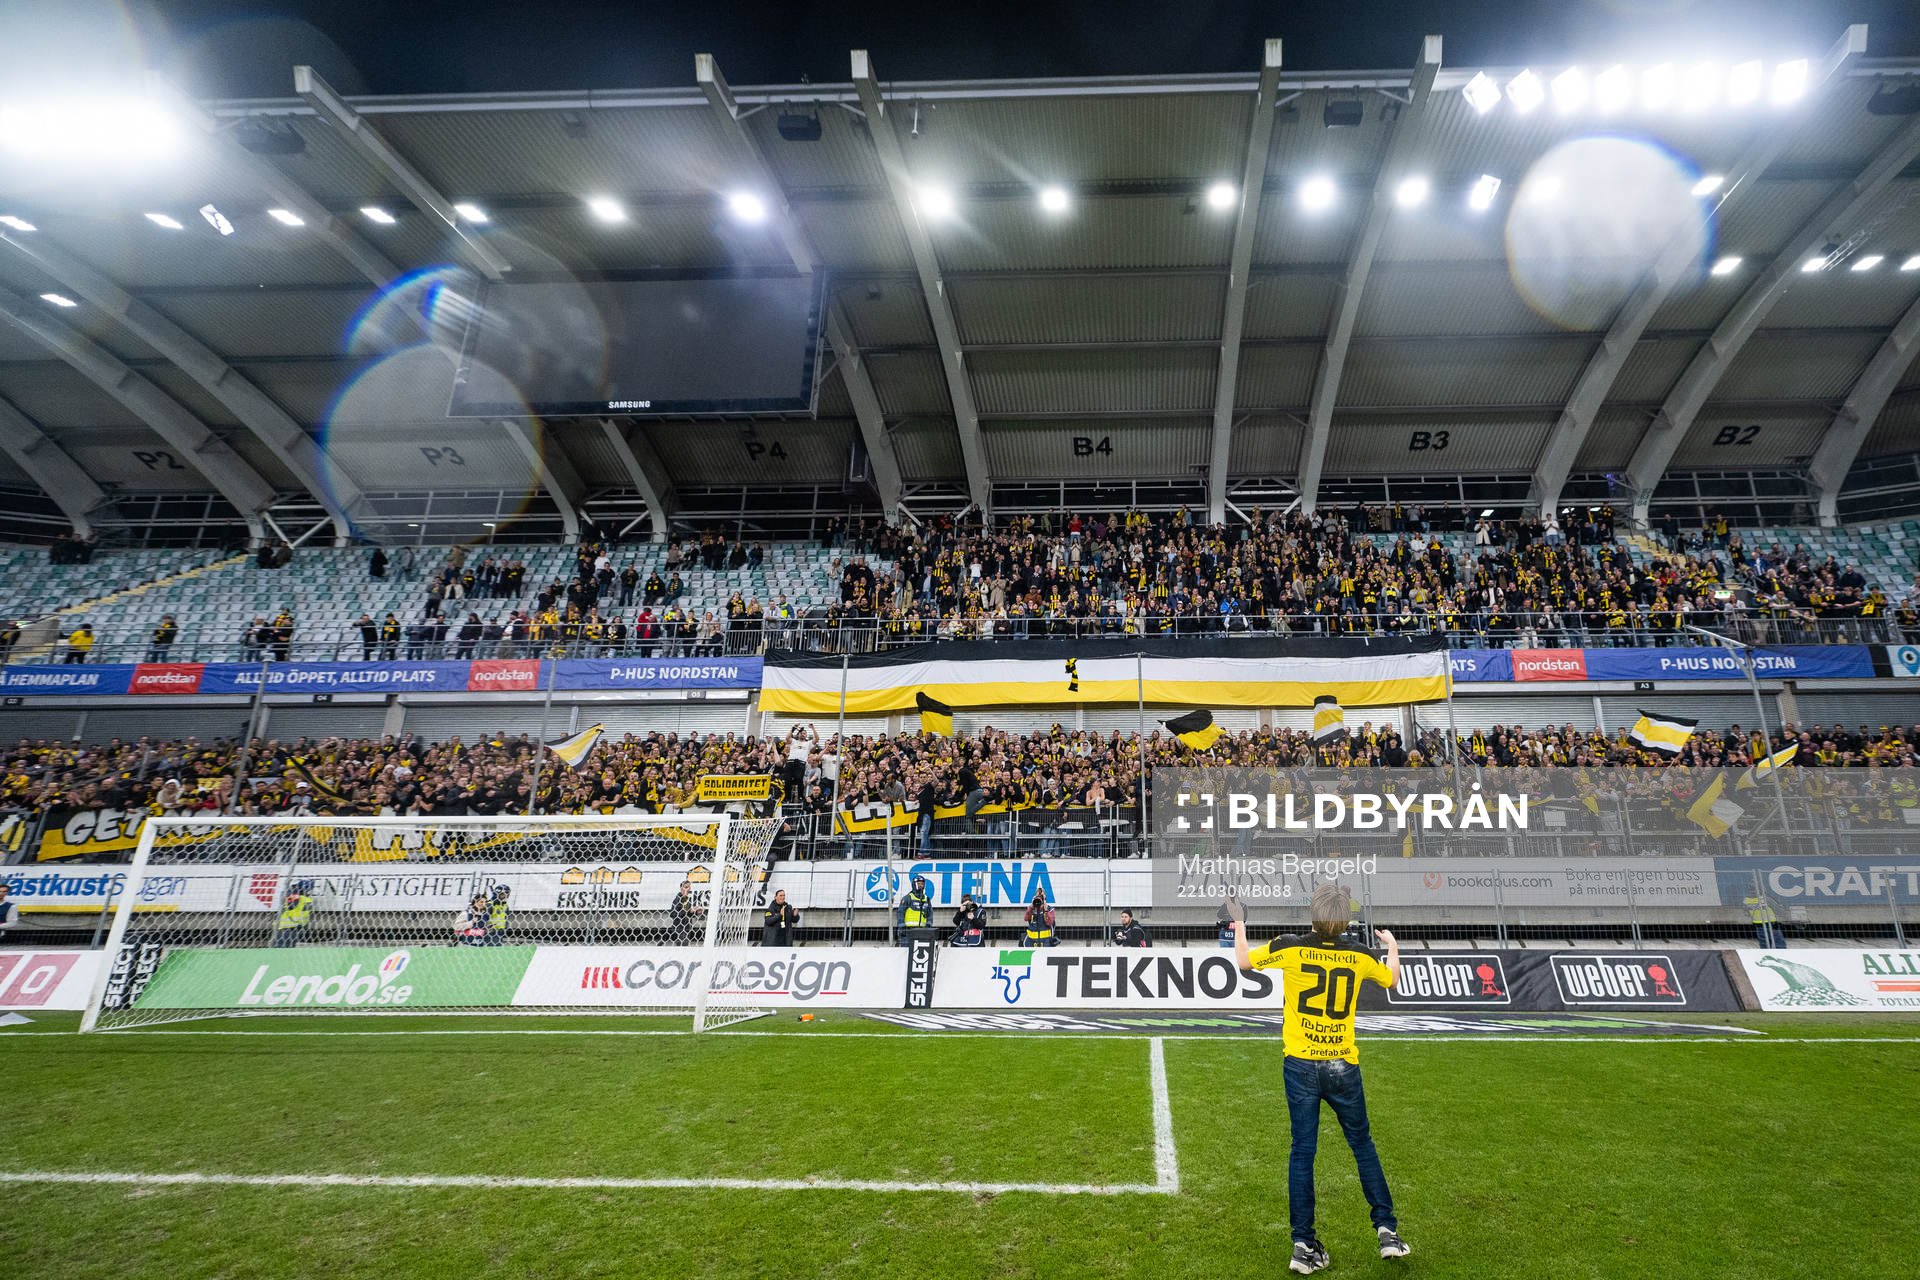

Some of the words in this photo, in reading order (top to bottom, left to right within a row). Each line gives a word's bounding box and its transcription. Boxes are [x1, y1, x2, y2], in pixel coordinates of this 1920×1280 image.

[608, 400, 650, 409] SAMSUNG
[1409, 431, 1450, 451] B3
[1713, 425, 1761, 446] B2
[420, 446, 466, 467] P3
[746, 441, 788, 461] P4
[1073, 437, 1113, 457] B4
[132, 450, 186, 471] P2
[610, 667, 656, 680] P-HUS
[658, 666, 738, 680] NORDSTAN
[1518, 658, 1580, 671] nordstan
[1660, 657, 1709, 671] P-HUS
[1712, 656, 1796, 671] NORDSTAN
[9, 673, 99, 686] HEMMAPLAN
[137, 672, 196, 685] nordstan
[287, 668, 338, 686] ÖPPET,
[340, 671, 389, 683] ALLTID
[392, 669, 436, 682] PLATS
[474, 668, 533, 682] nordstan
[704, 778, 768, 789] SOLIDARITET
[909, 862, 1056, 905] STENA
[1569, 883, 1583, 897] på
[1586, 884, 1628, 895] mindre
[1648, 886, 1662, 895] en
[1666, 884, 1704, 895] minut!
[1768, 865, 1920, 898] CRAFT
[1256, 953, 1285, 968] stadium
[1299, 948, 1358, 965] Glimstedt
[1862, 953, 1920, 975] ALL
[909, 939, 931, 1007] SELECT
[1046, 956, 1274, 1000] TEKNOS
[1396, 956, 1474, 998] weber
[1560, 956, 1648, 998] weber
[1297, 963, 1356, 1020] 20
[1304, 1032, 1344, 1044] MAXXIS
[1310, 1048, 1339, 1057] prefab
